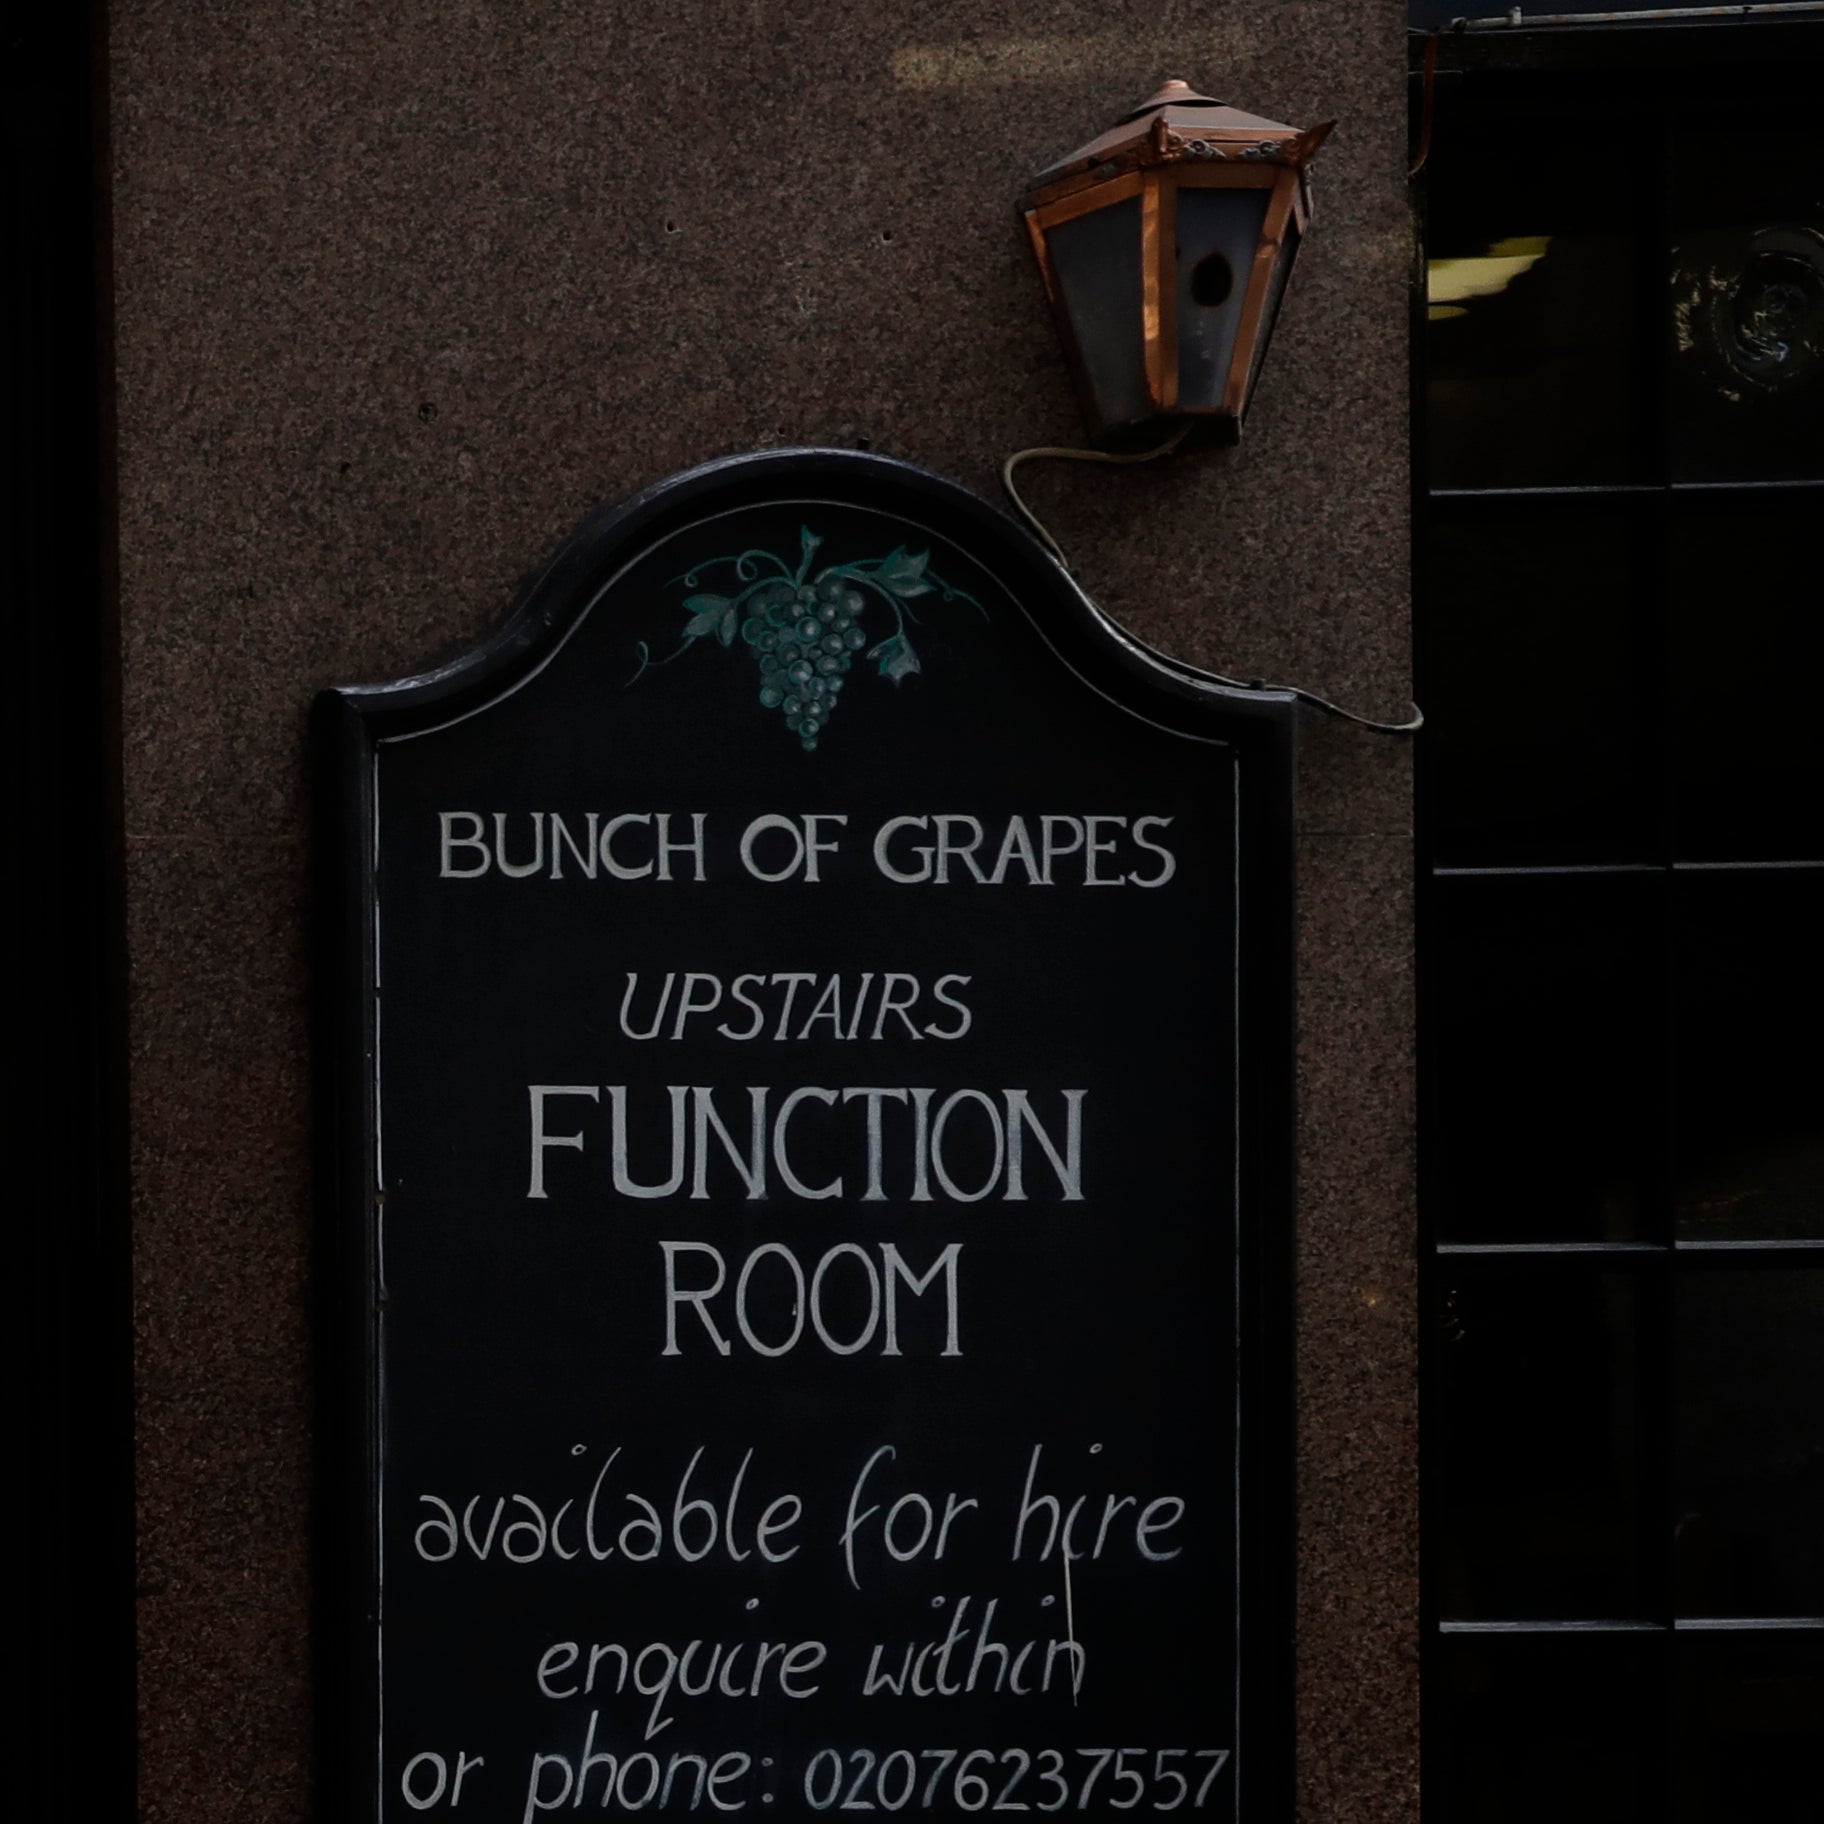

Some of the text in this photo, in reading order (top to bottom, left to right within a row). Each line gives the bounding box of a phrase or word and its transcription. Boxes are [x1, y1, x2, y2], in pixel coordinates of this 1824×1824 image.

[440, 812, 1175, 887] BUNCH OF GRAPES
[620, 973, 971, 1040] UPSTAIRS
[528, 1085, 1087, 1202] FUNCTION
[659, 1241, 963, 1356] ROOM
[415, 1444, 1184, 1592] available for hire
[538, 1594, 1084, 1734] enquire within
[402, 1752, 483, 1809] or
[805, 1749, 1225, 1810] 02076237557
